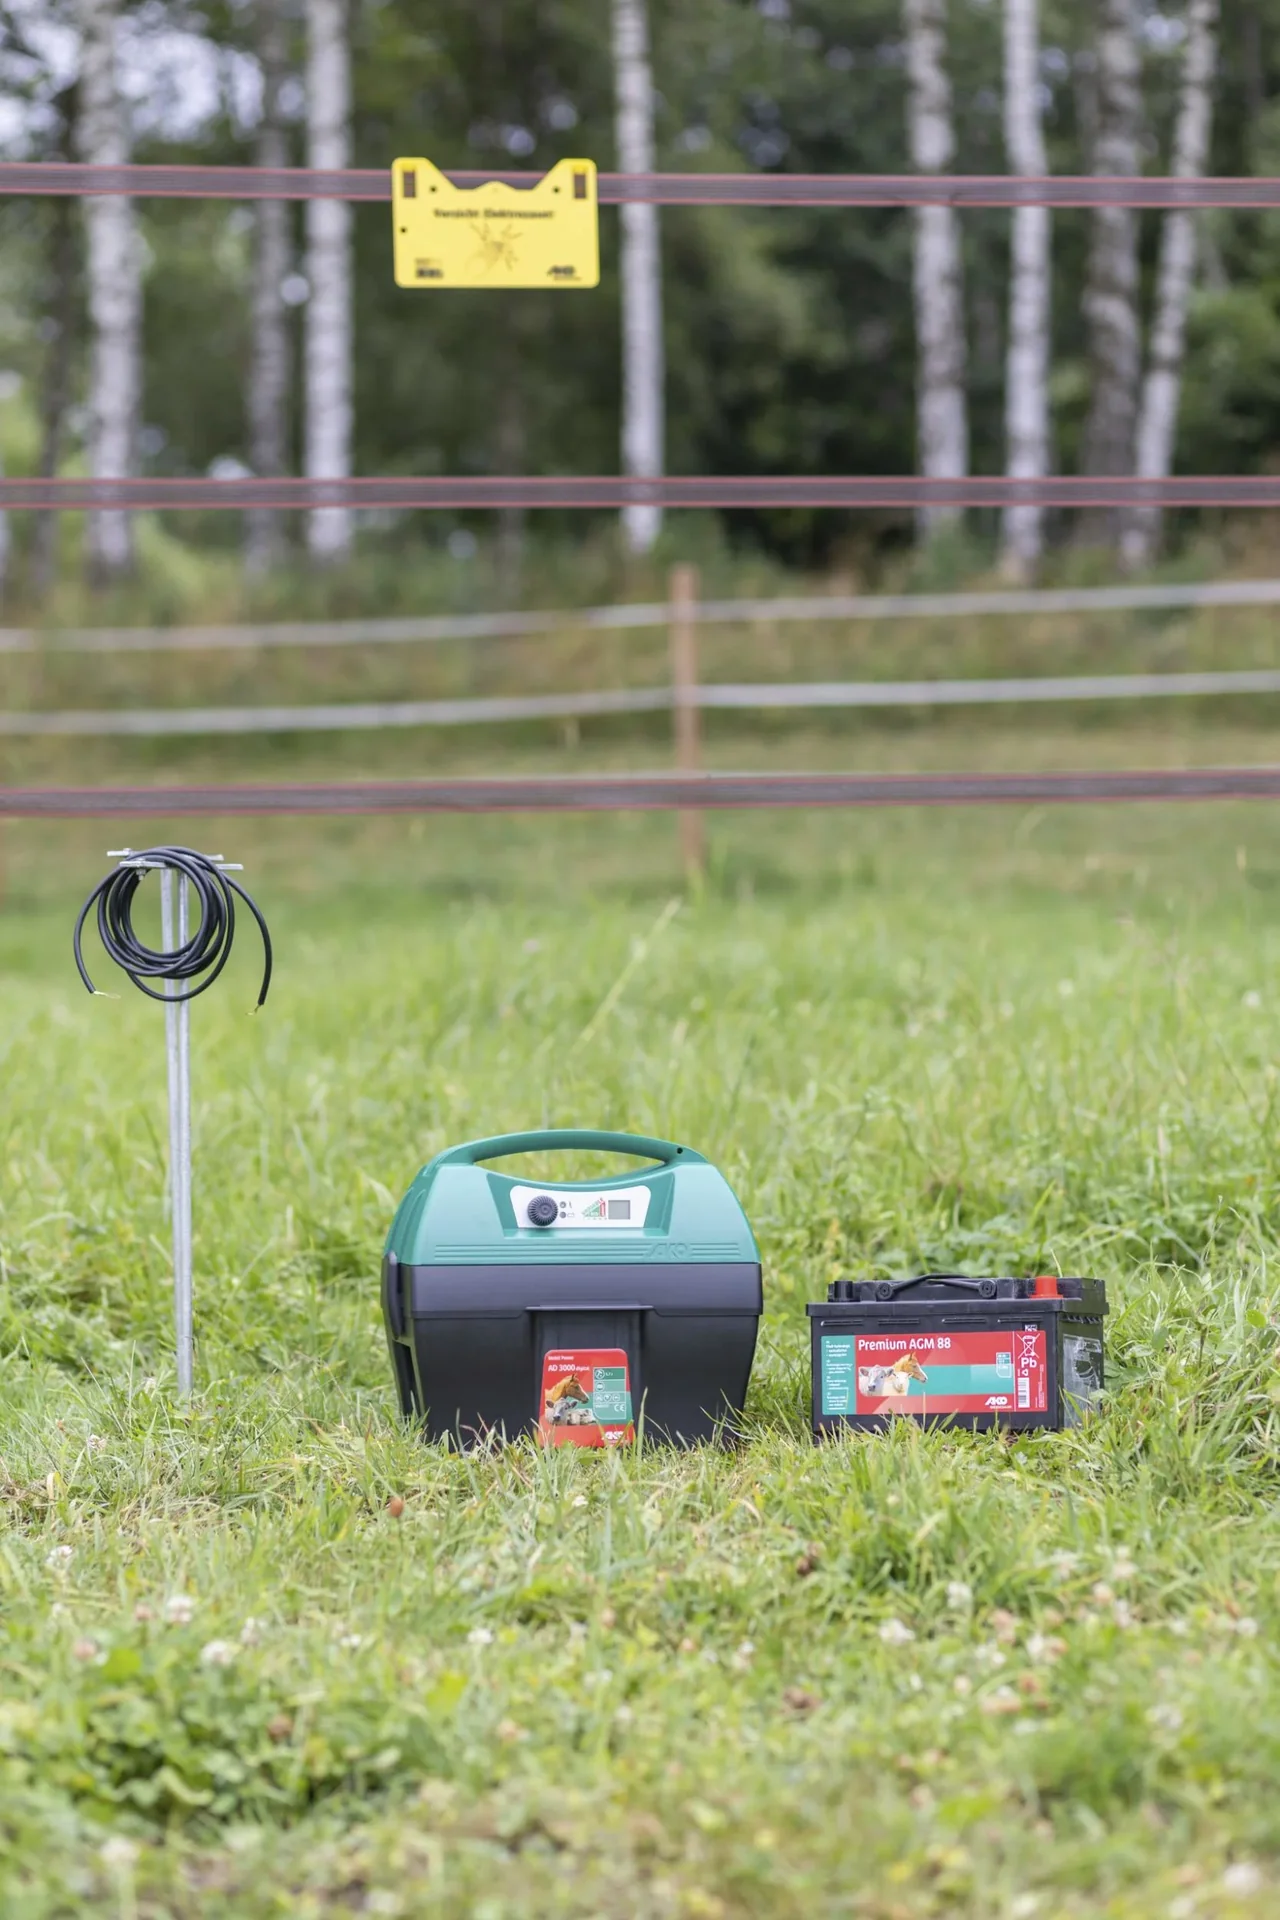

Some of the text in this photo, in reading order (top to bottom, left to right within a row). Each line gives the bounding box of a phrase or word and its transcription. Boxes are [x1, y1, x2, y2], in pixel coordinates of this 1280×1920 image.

[858, 1339, 907, 1351] Premium
[909, 1338, 935, 1350] AGM
[937, 1337, 951, 1349] 88
[547, 1364, 558, 1372] AD
[558, 1364, 576, 1372] 3000
[1021, 1358, 1037, 1368] Pb
